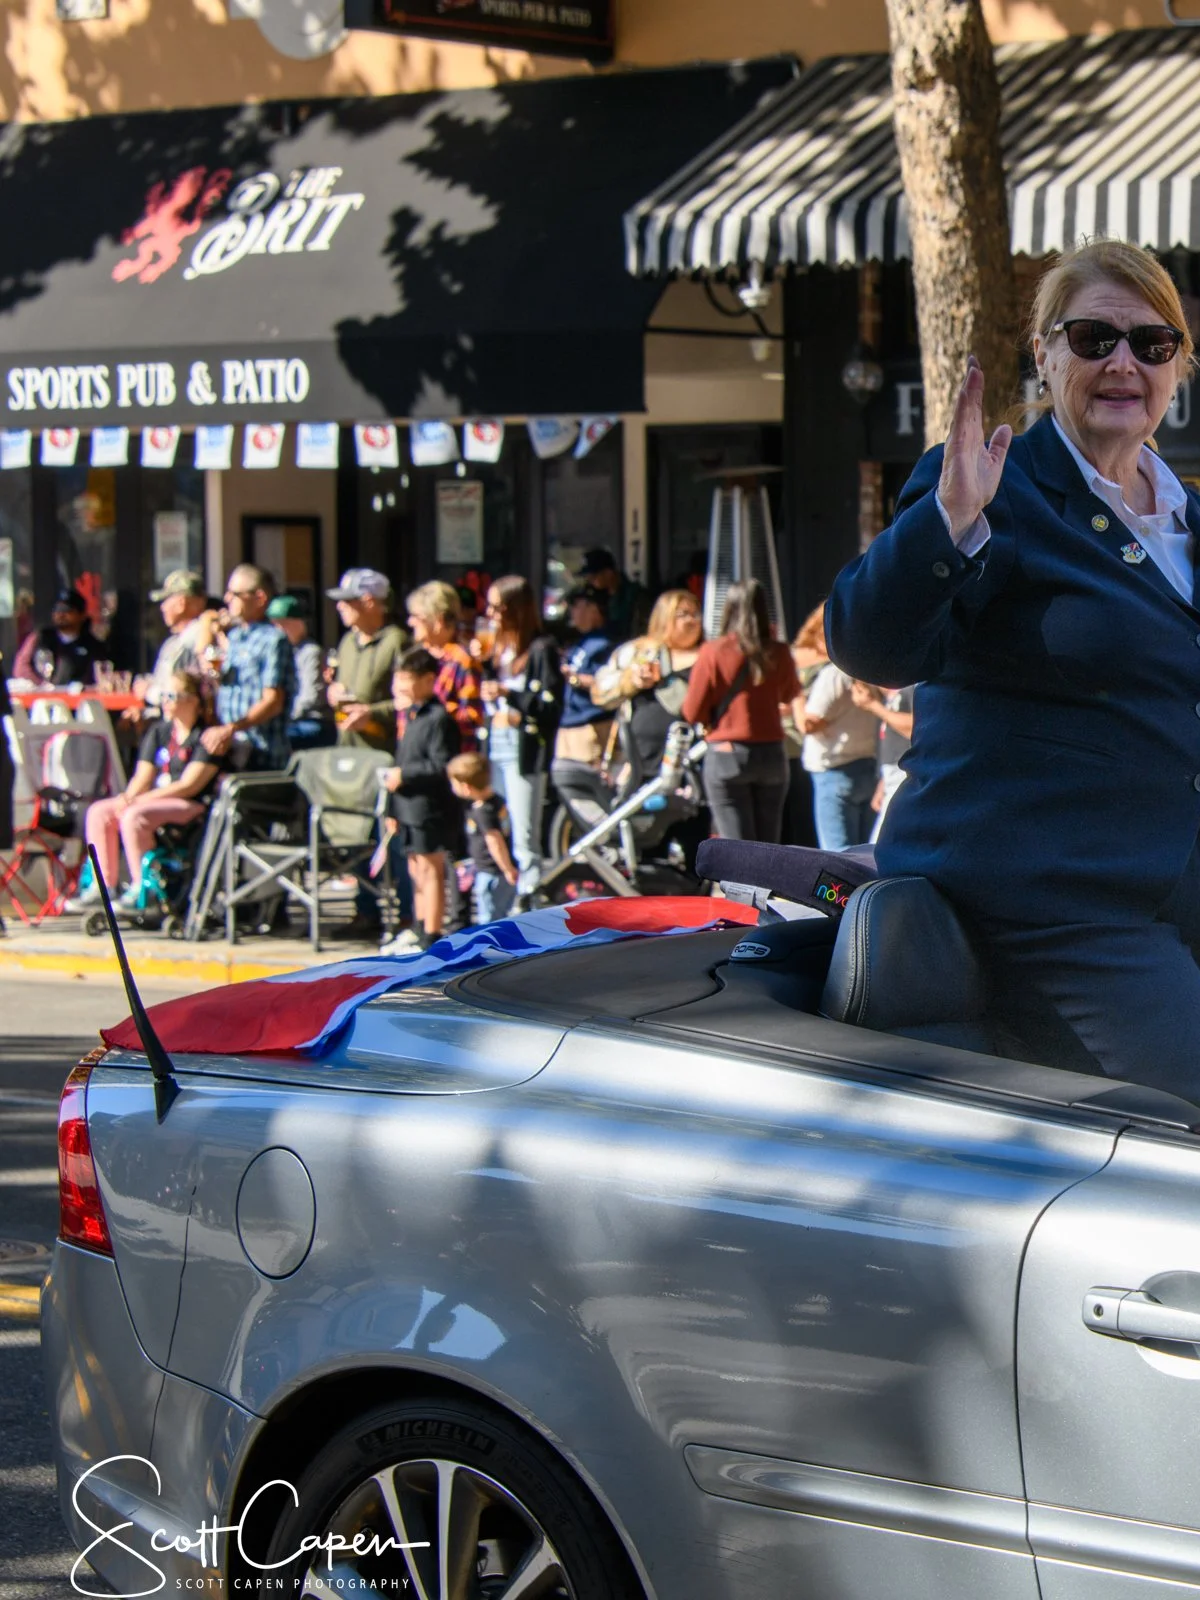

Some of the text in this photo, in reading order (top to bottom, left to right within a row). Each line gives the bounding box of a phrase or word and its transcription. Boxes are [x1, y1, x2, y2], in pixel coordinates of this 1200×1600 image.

[521, 0, 546, 21] PUB
[558, 6, 592, 28] PATIO
[284, 166, 343, 197] THE
[8, 358, 310, 410] SPORTS PUB & PATIO
[384, 1419, 491, 1452] MICHELIN
